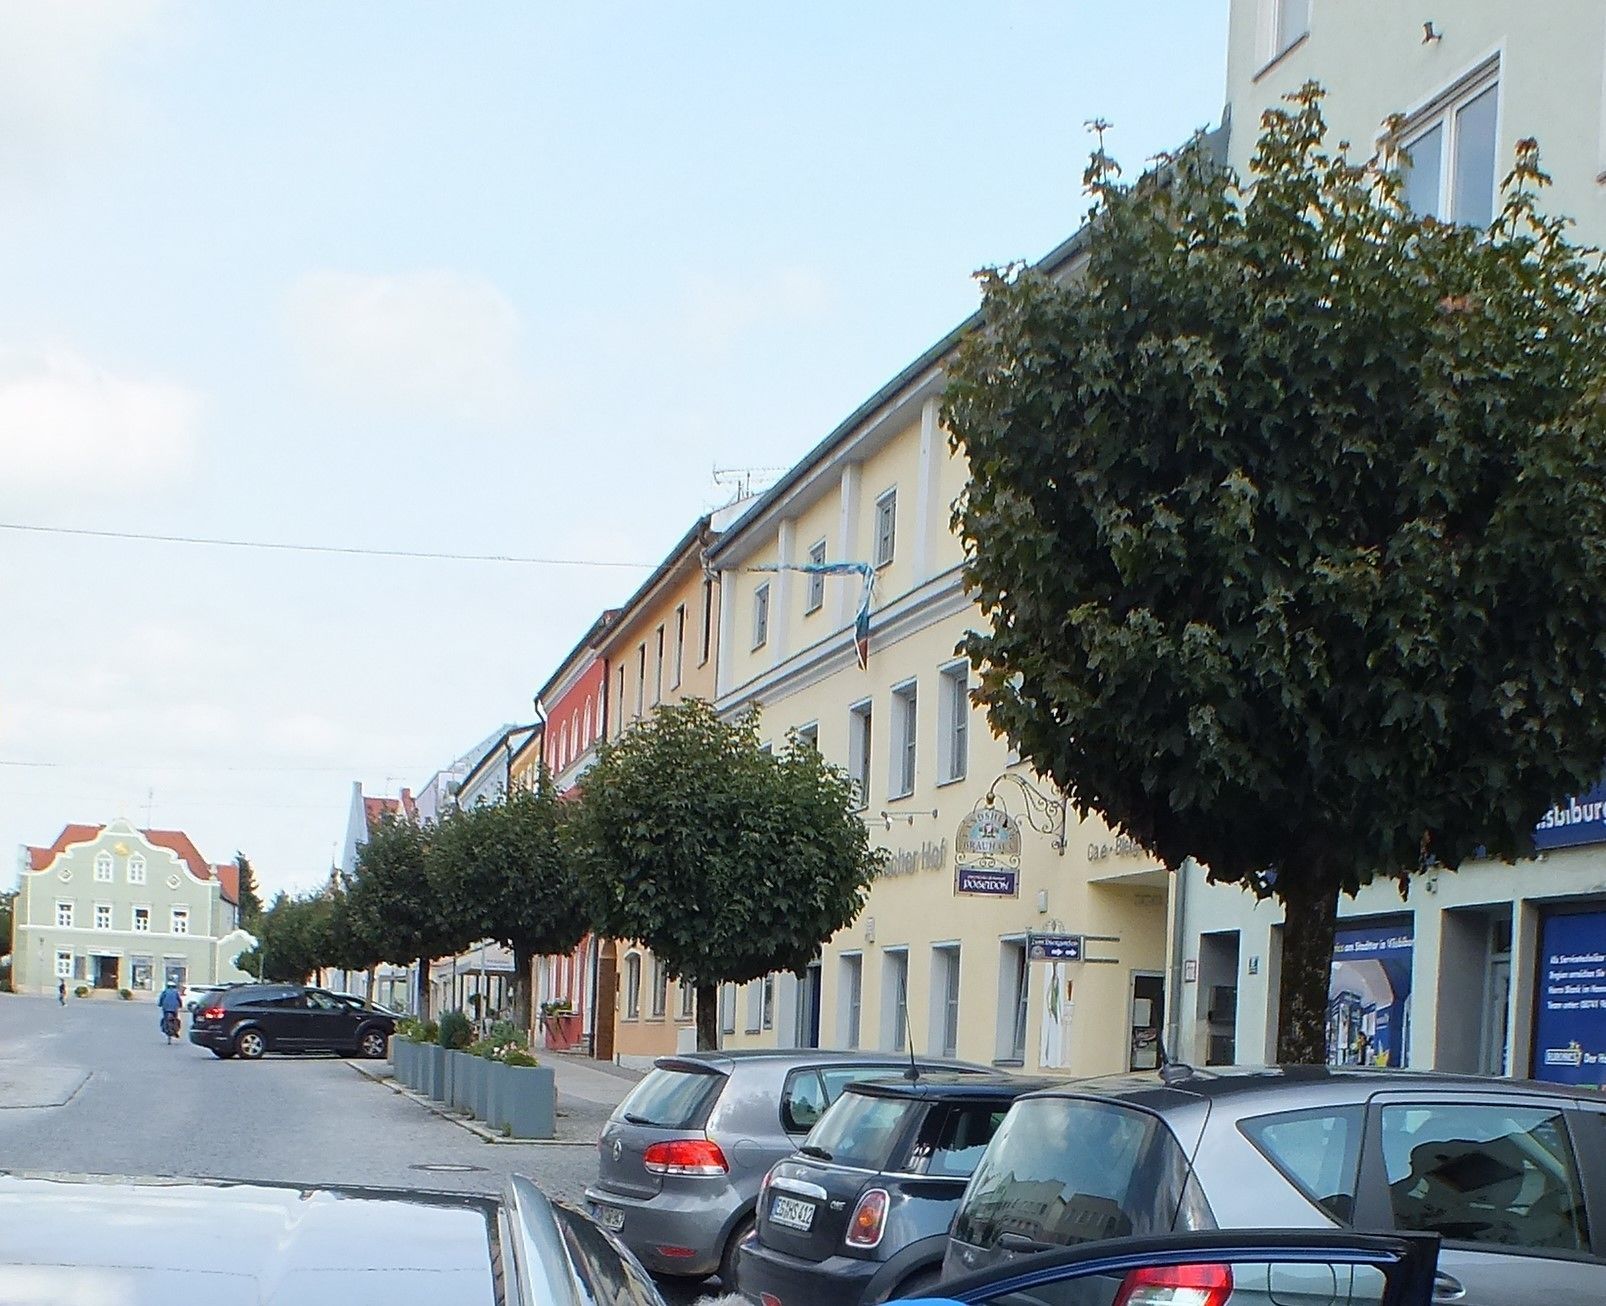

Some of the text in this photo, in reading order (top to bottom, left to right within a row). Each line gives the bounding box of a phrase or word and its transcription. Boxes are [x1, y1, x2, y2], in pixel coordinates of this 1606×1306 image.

[1536, 797, 1606, 830] sbibur
[921, 837, 946, 871] Hof
[963, 879, 1009, 890] POSEIDON
